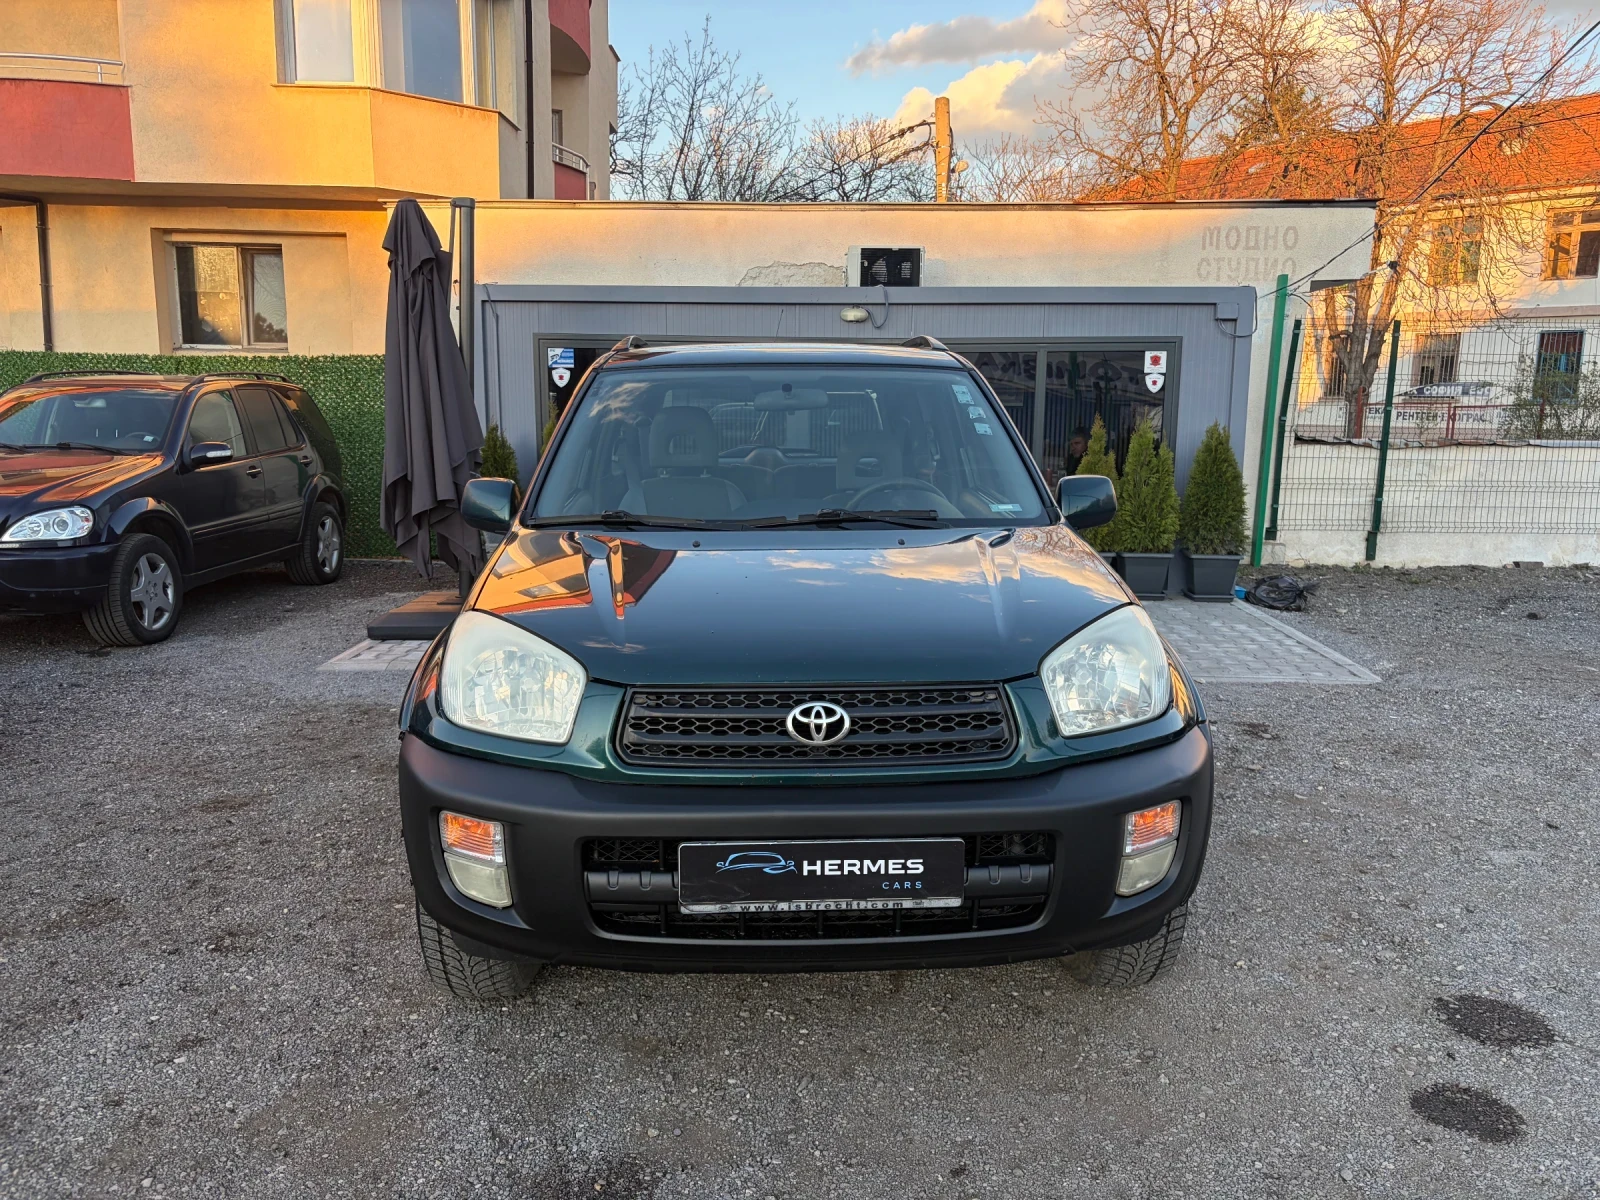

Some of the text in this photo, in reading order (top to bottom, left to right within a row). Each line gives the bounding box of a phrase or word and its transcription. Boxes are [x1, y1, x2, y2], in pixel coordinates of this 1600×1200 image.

[1201, 225, 1299, 251] МОДНО
[1197, 256, 1298, 282] СТУДИО
[1423, 385, 1463, 396] СОФИЯ
[802, 858, 925, 876] HERMES
[881, 881, 923, 890] CARS
[740, 901, 904, 912] www.isbrecht.com
